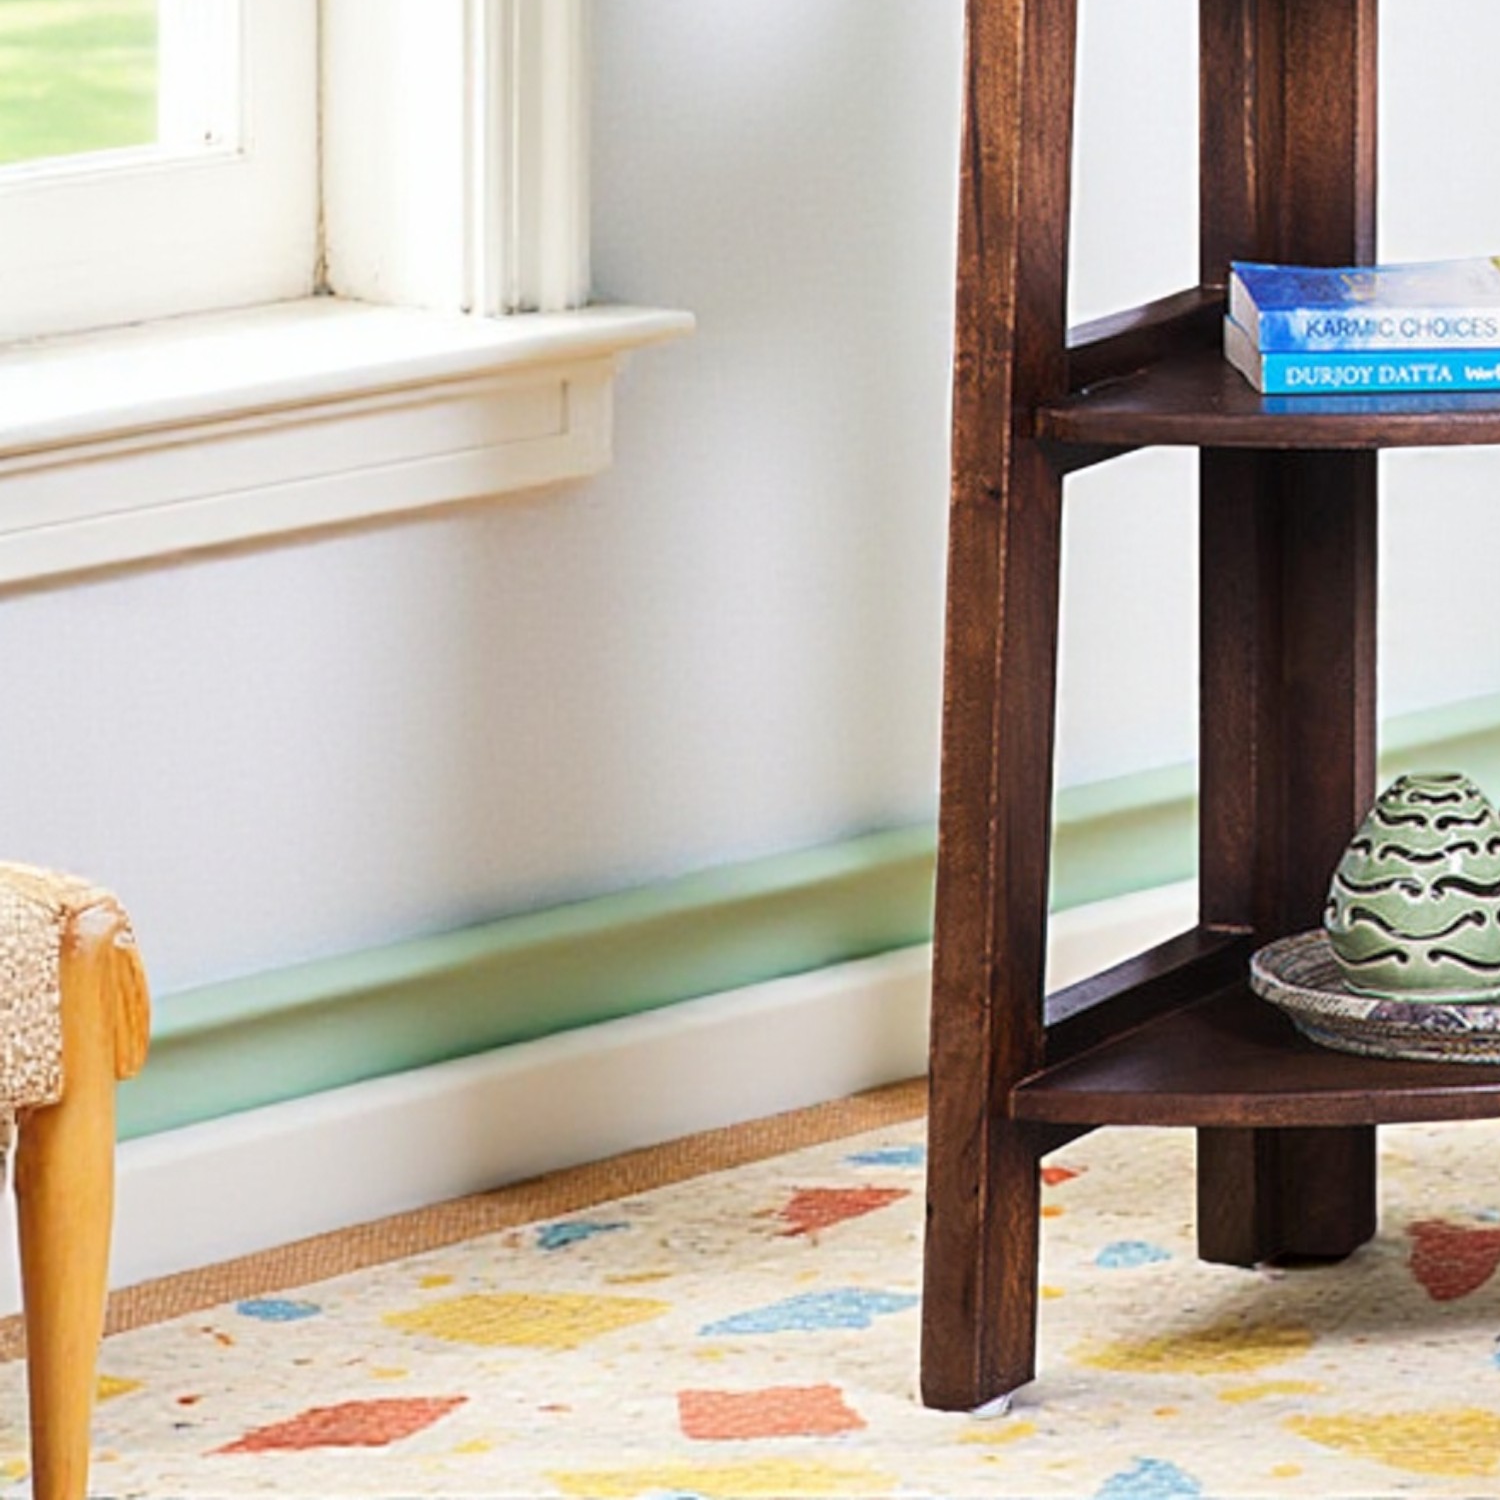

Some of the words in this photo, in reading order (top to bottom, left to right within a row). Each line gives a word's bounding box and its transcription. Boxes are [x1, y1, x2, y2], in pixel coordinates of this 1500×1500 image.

[1305, 316, 1395, 338] KARMIC
[1399, 316, 1499, 338] CHOICES
[1286, 365, 1374, 387] DURJOY
[1378, 363, 1453, 384] DATTA
